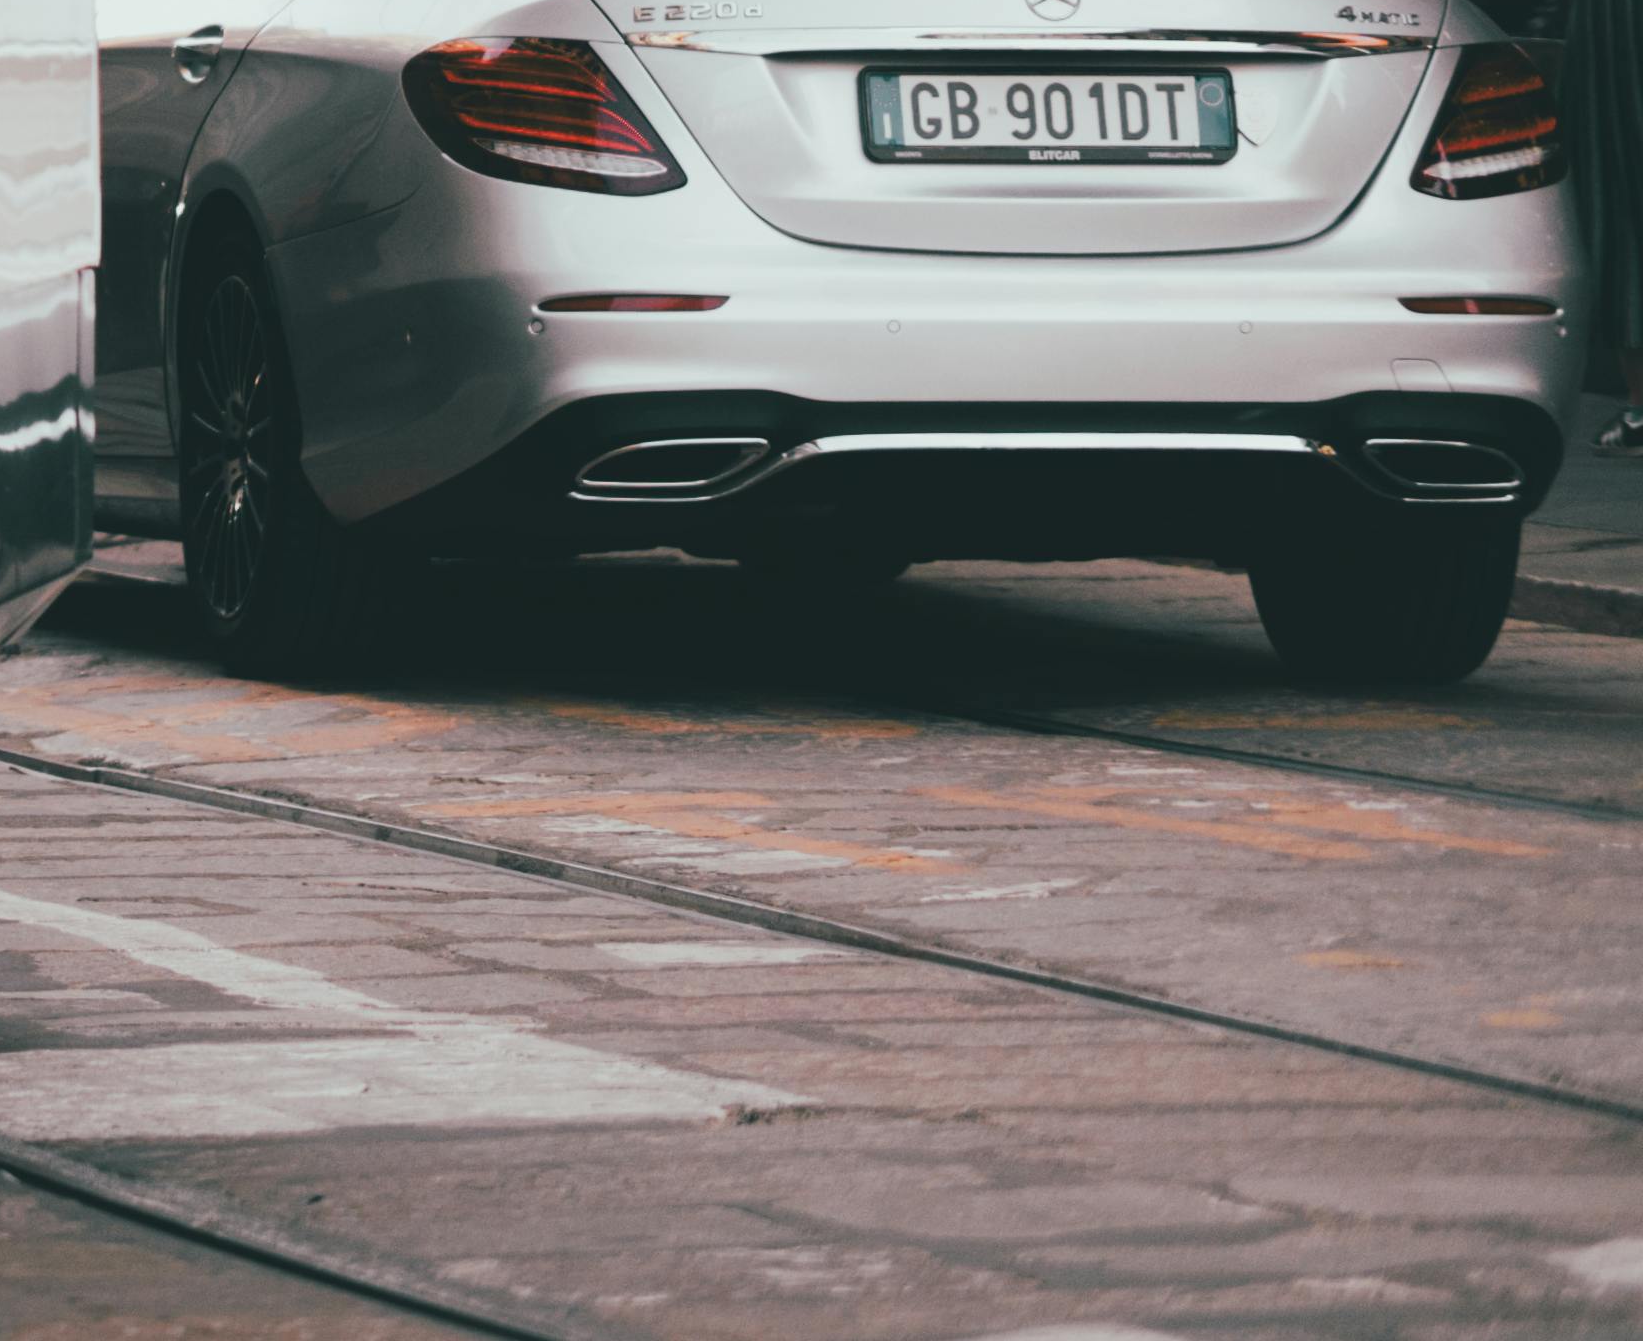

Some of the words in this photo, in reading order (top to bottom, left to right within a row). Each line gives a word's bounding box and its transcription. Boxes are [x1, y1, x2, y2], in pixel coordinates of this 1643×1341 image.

[633, 4, 656, 23] E
[910, 81, 980, 140] GB
[1006, 82, 1186, 141] 901DT
